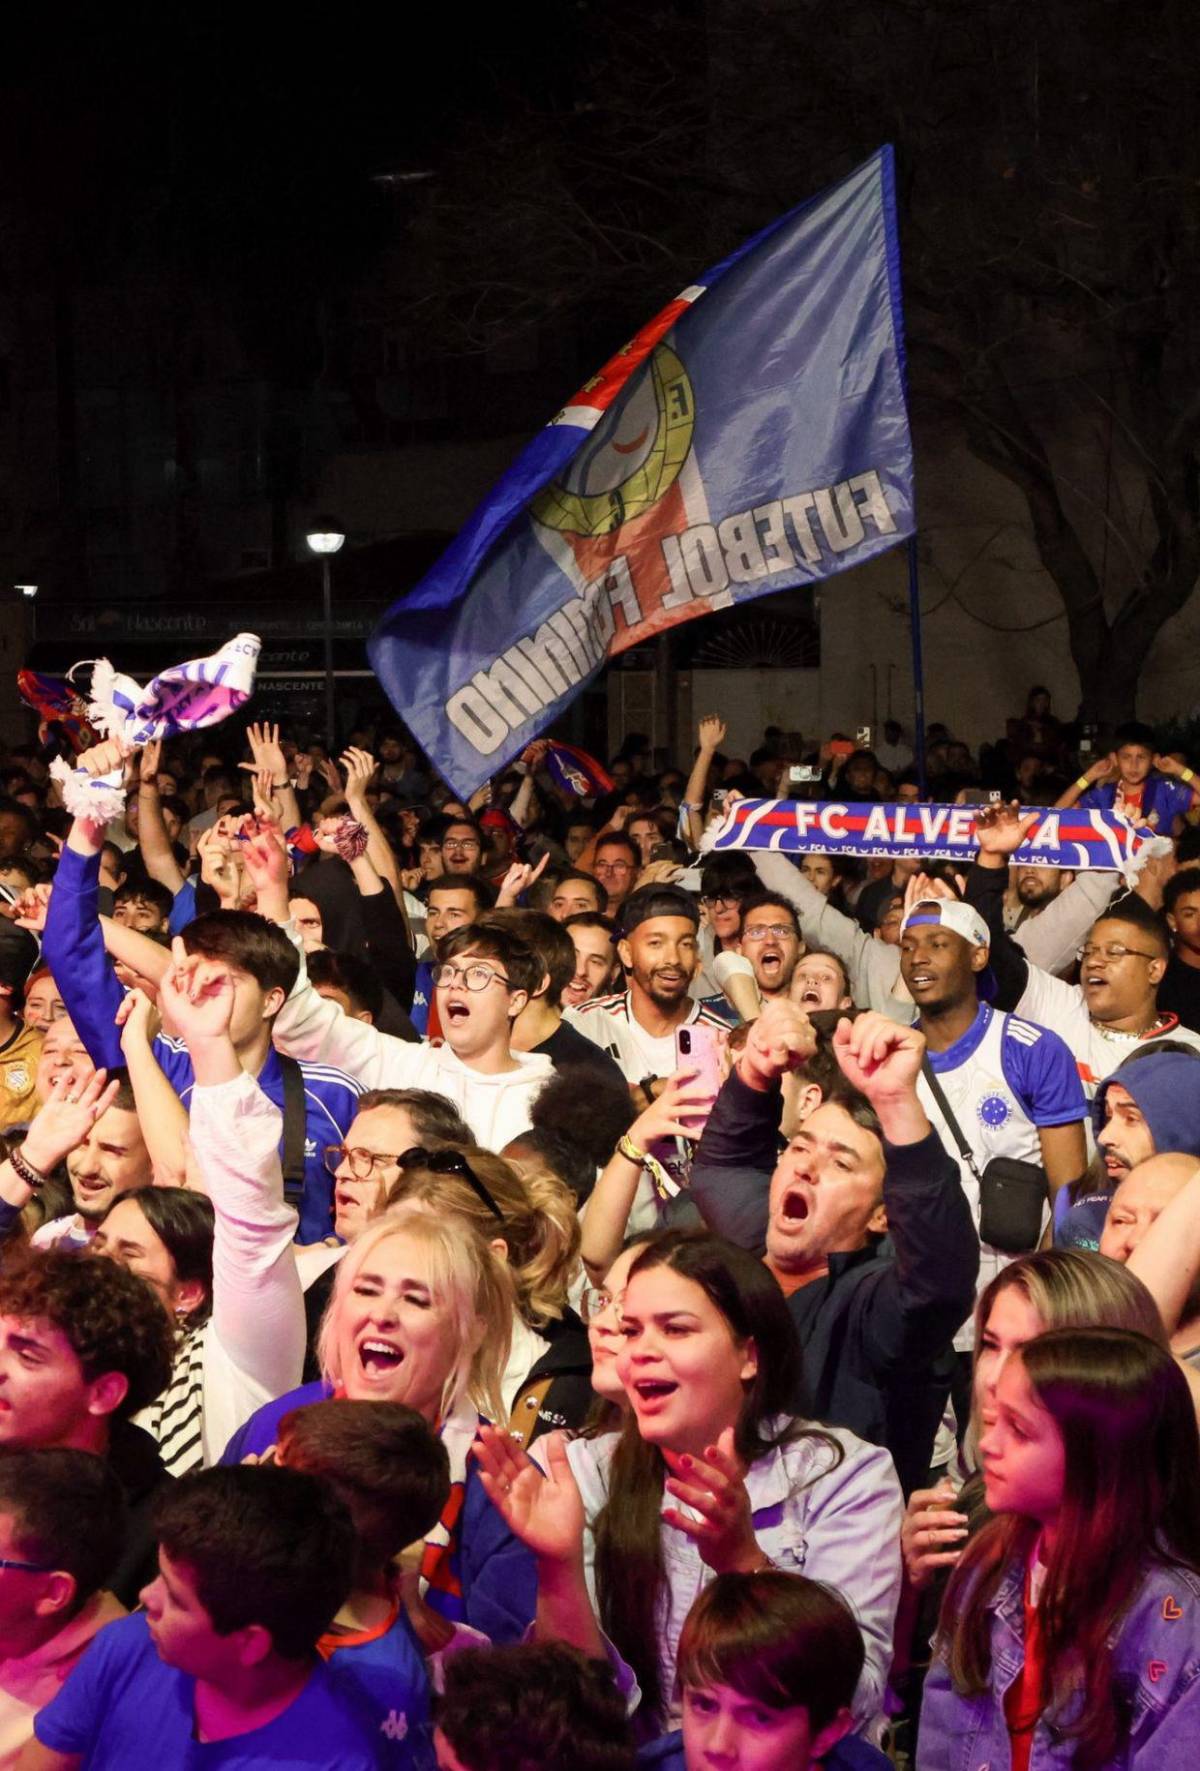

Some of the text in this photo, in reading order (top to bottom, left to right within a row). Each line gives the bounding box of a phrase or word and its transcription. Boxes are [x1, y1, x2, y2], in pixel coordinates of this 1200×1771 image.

[257, 681, 325, 691] NASCENTE
[795, 802, 1061, 850] FC ALVEA
[810, 843, 826, 852] FCA
[841, 845, 857, 854] FCA
[872, 847, 888, 855] FCA
[904, 848, 919, 856] FCA
[1031, 855, 1047, 864] FCA
